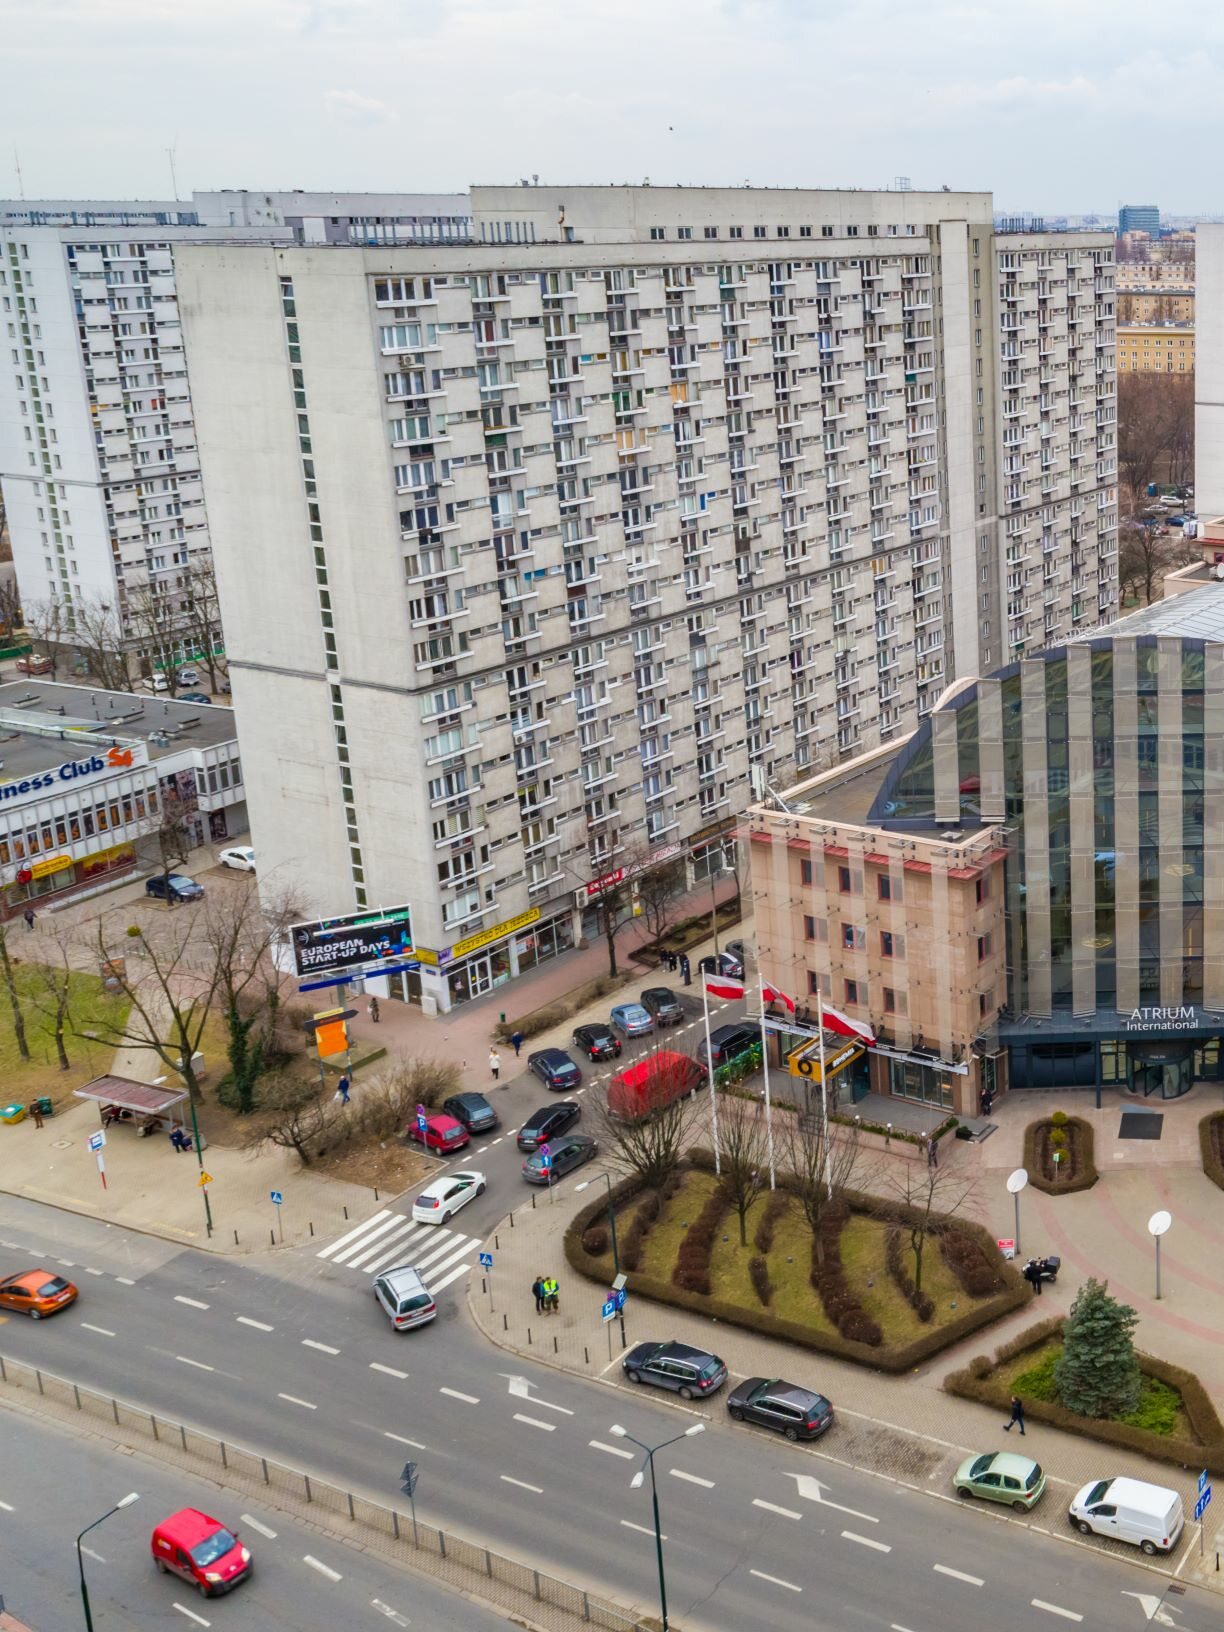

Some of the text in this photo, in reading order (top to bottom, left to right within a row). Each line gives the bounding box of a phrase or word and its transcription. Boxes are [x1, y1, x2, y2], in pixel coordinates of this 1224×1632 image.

[0, 773, 54, 800] ness
[59, 756, 105, 780] Club
[301, 938, 364, 958] EUROPEAN
[301, 940, 390, 966] START-UP DAYS
[1131, 1006, 1195, 1020] ATRIUM
[1126, 1019, 1199, 1031] International
[618, 1291, 624, 1303] P
[605, 1302, 613, 1315] P
